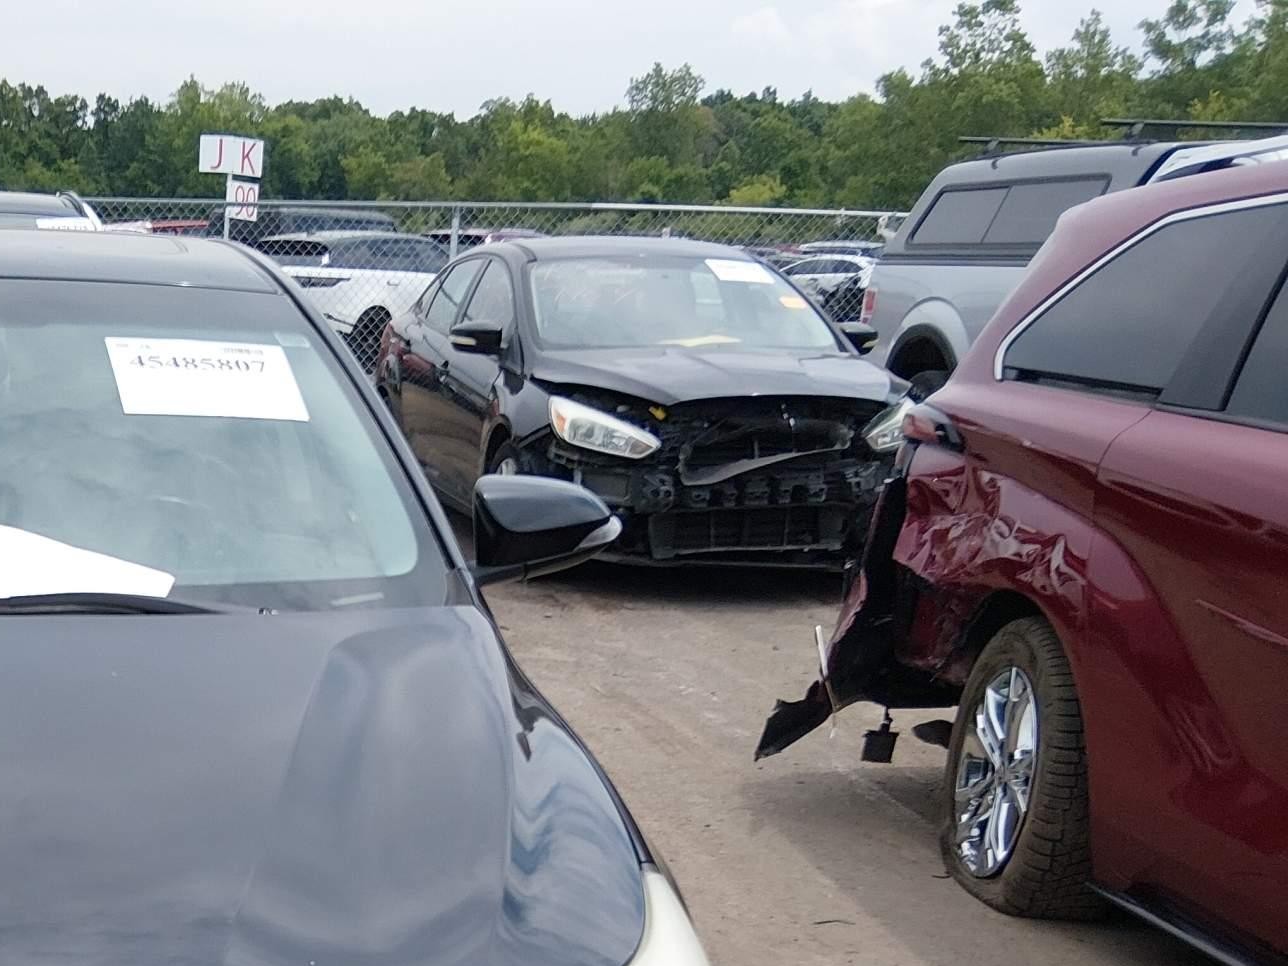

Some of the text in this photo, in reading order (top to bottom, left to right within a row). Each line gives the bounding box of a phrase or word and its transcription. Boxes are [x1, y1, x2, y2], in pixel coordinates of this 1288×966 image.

[210, 138, 257, 175] J K
[235, 185, 256, 218] 90
[129, 354, 265, 373] 45485807
